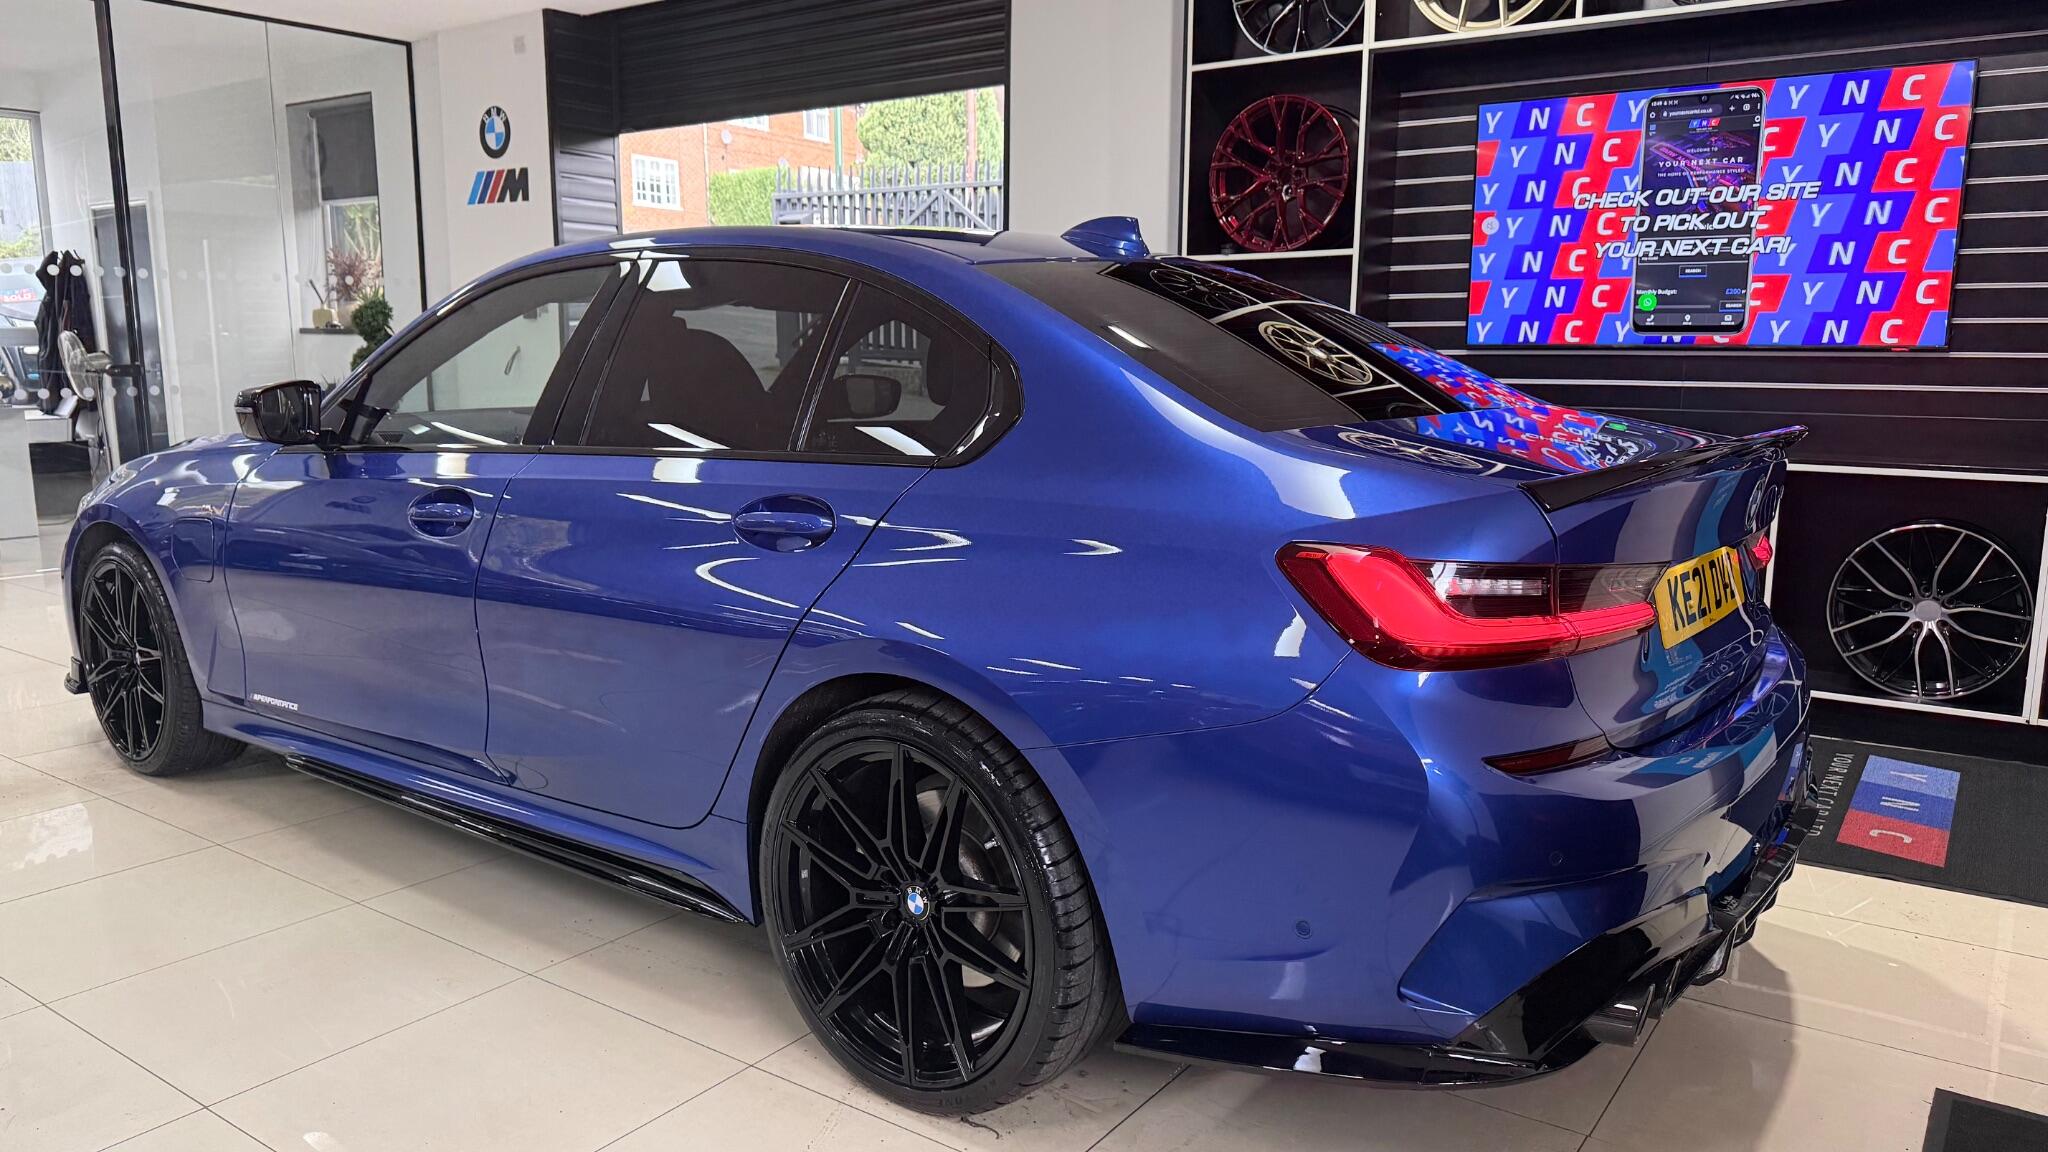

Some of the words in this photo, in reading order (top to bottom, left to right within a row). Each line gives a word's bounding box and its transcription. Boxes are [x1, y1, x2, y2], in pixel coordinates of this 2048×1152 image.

[1485, 111, 1503, 134] Y
[1528, 107, 1550, 131] N
[1576, 102, 1595, 127] C
[1628, 98, 1648, 123] Y
[1788, 84, 1810, 110] Y
[1841, 79, 1870, 106] N
[1902, 73, 1926, 101] C
[1510, 145, 1528, 168] Y
[1553, 141, 1576, 166] N
[1602, 137, 1621, 162] C
[1818, 122, 1840, 148] Y
[1872, 118, 1901, 145] N
[1934, 113, 1959, 141] C
[1658, 160, 1686, 168] YOUR
[1691, 158, 1718, 166] NEXT
[1722, 156, 1744, 164] CAR
[1482, 182, 1500, 205] Y
[1524, 179, 1547, 203] N
[1833, 161, 1862, 187] N
[1894, 157, 1918, 184] C
[1573, 189, 1653, 209] CHECK
[1655, 187, 1707, 206] OUT
[1705, 183, 1762, 204] OUR
[1765, 181, 1822, 201] SITE
[1506, 216, 1524, 239] Y
[1548, 214, 1572, 237] N
[1596, 211, 1616, 236] C
[1811, 202, 1833, 227] Y
[1863, 199, 1893, 226] N
[1924, 196, 1949, 223] C
[1620, 215, 1651, 233] TO
[1653, 212, 1710, 232] PICK
[1711, 209, 1768, 231] OUT
[1479, 252, 1497, 274] Y
[1521, 250, 1544, 273] N
[1568, 248, 1587, 272] C
[1827, 240, 1856, 266] N
[1887, 238, 1911, 265] C
[1594, 240, 1657, 259] YOUR
[1659, 238, 1729, 257] NEXT
[1501, 287, 1519, 309] Y
[1543, 285, 1566, 309] N
[1591, 284, 1611, 308] C
[1802, 281, 1824, 305] Y
[1855, 280, 1884, 305] N
[1915, 278, 1939, 305] C
[1476, 321, 1493, 343] Y
[1517, 320, 1540, 343] N
[1564, 319, 1583, 343] C
[1769, 320, 1791, 343] Y
[1821, 319, 1849, 344] N
[1879, 318, 1903, 344] C
[1666, 564, 1711, 632] KE21
[1827, 752, 1855, 773] YOUR
[1818, 773, 1845, 797] NEXT
[1889, 770, 1928, 783] Y
[1879, 795, 1921, 812] N
[1868, 828, 1913, 844] C
